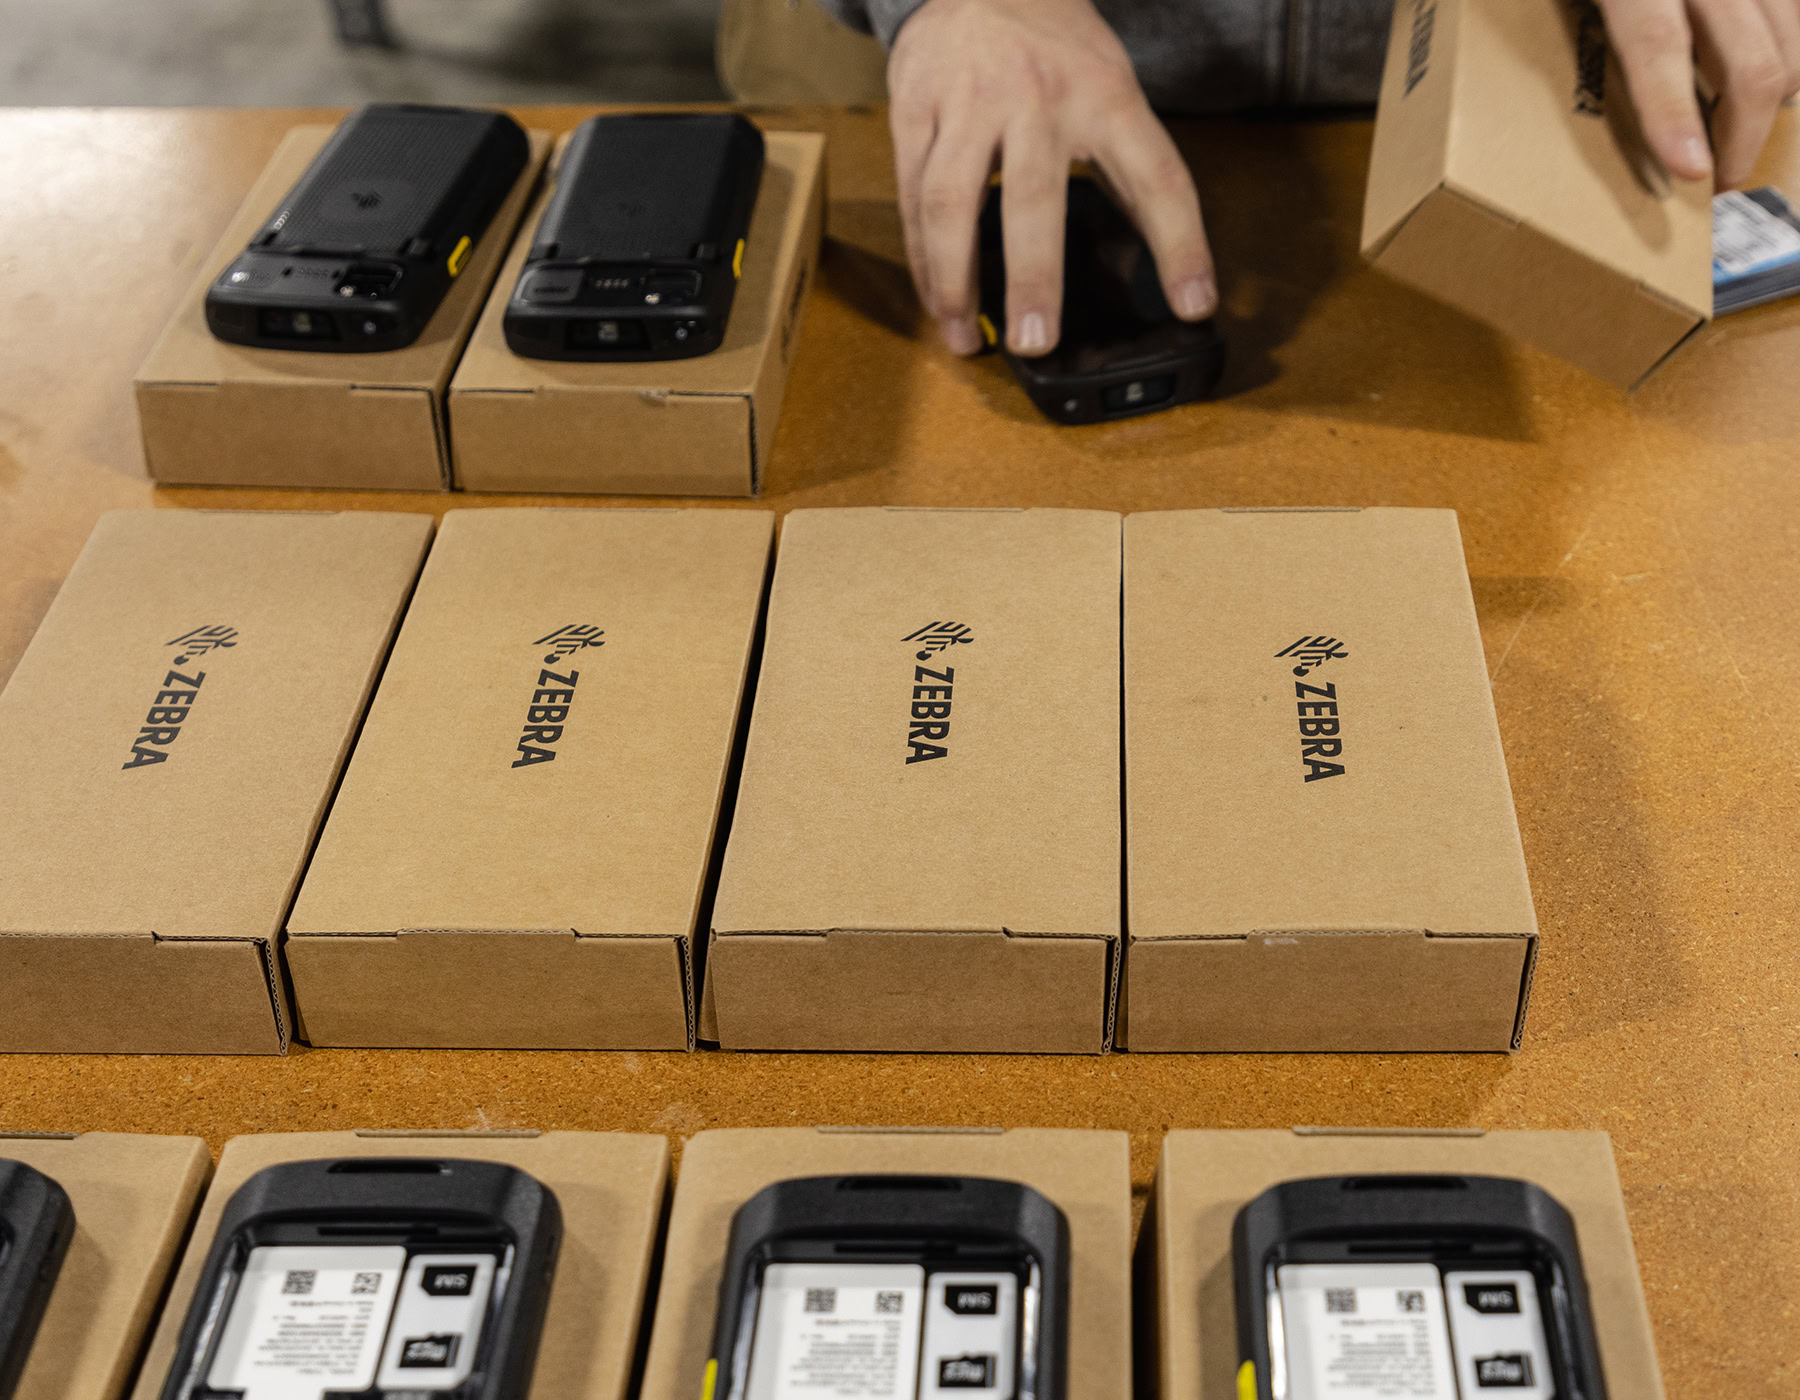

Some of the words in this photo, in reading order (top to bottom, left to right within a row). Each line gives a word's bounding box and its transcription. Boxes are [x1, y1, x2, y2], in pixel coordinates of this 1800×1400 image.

[122, 669, 206, 769] ZEBRA
[511, 669, 579, 769] ZEBRA
[906, 665, 955, 765] ZEBRA
[1294, 681, 1346, 783] ZEBRA
[434, 1273, 468, 1289] SIM
[957, 1292, 992, 1309] SIM
[1478, 1290, 1513, 1308] SIM
